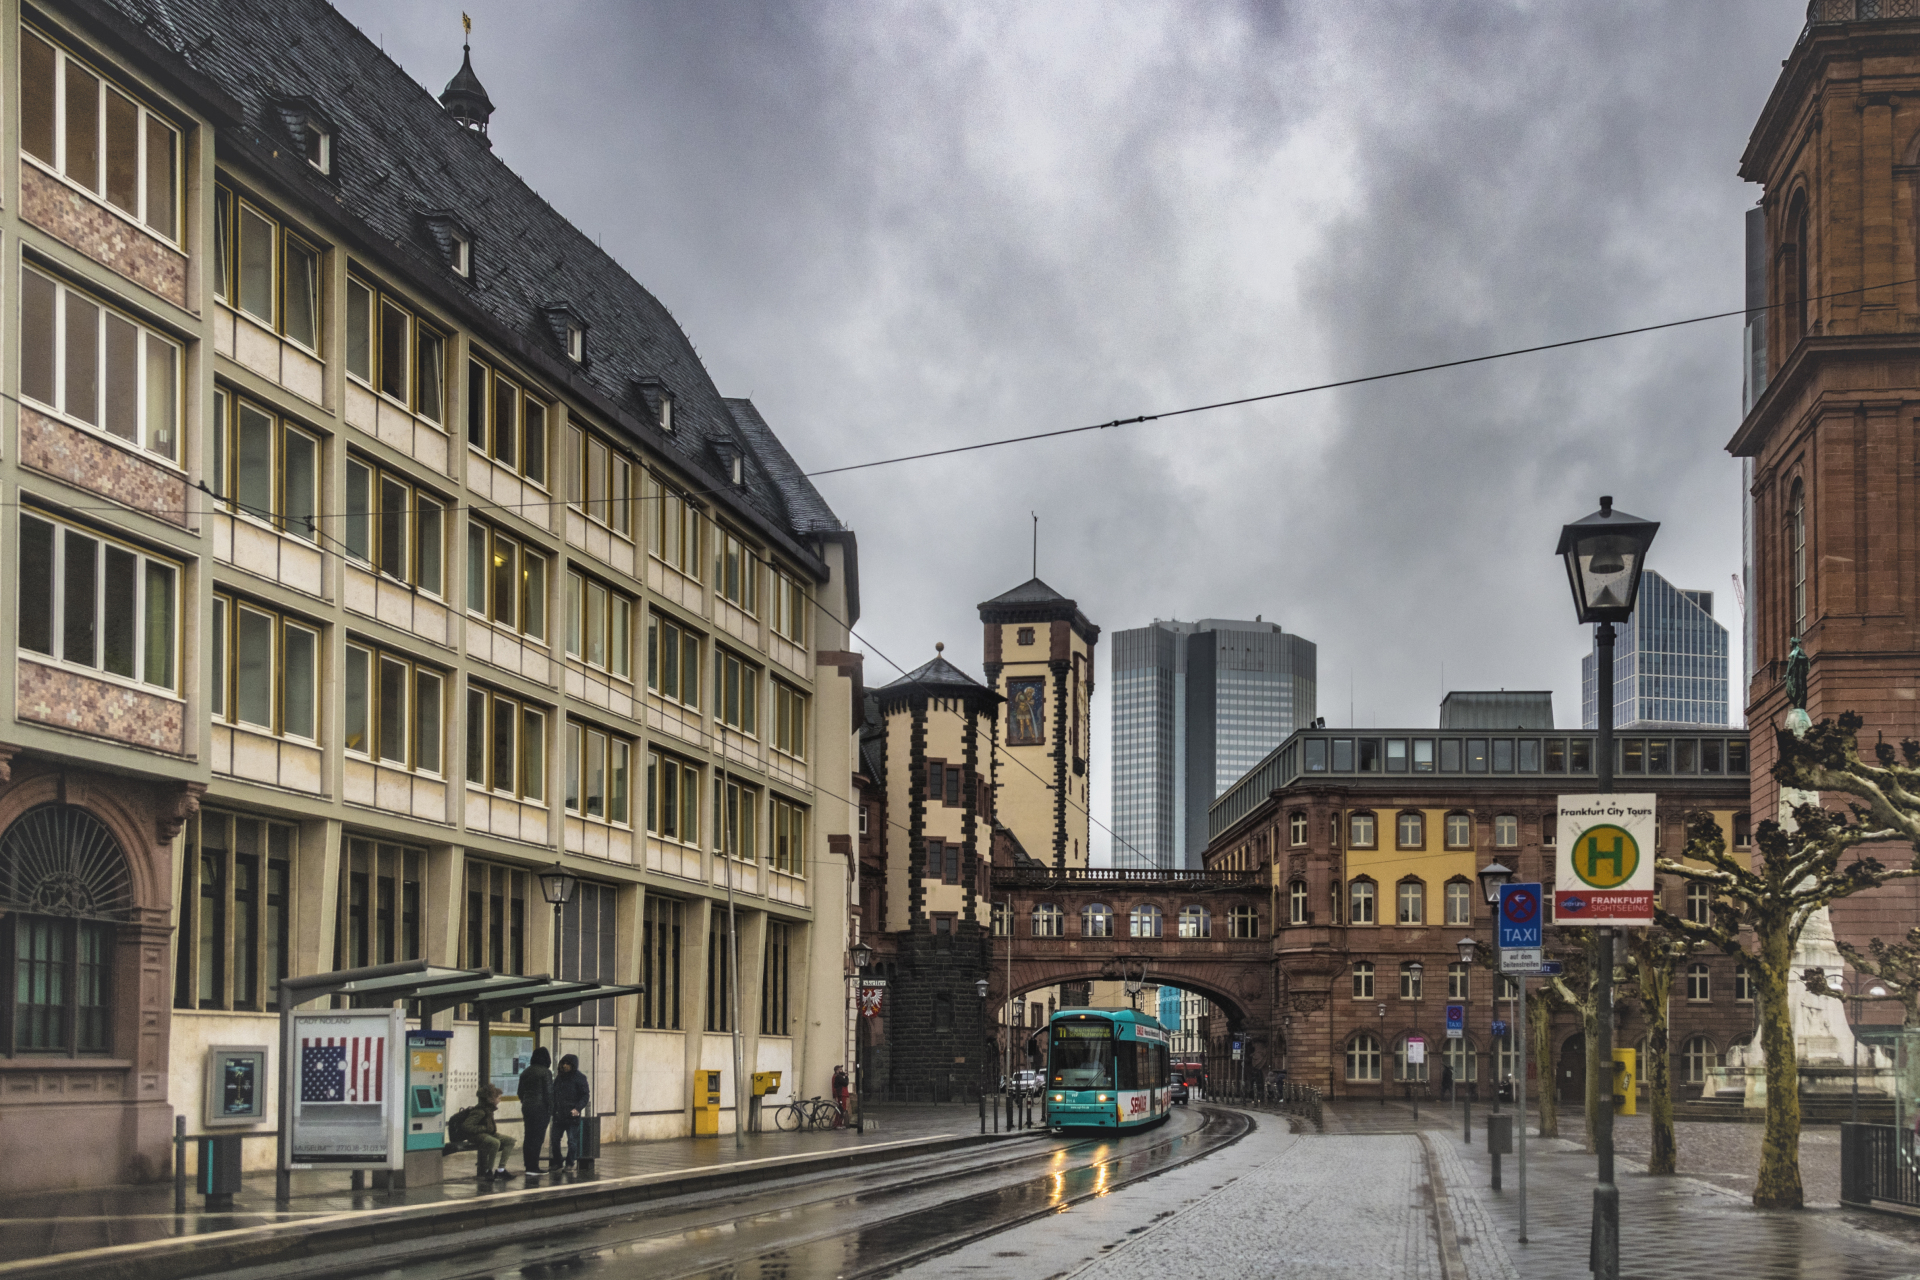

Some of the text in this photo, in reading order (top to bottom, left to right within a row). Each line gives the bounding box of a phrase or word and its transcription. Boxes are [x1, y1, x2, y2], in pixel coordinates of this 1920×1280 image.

[1560, 807, 1652, 817] Frankfurt City Tours
[1588, 836, 1623, 877] H
[1591, 904, 1649, 912] SIGHTSEEING
[1504, 928, 1537, 942] TAXI
[294, 1144, 327, 1152] MUSEUM
